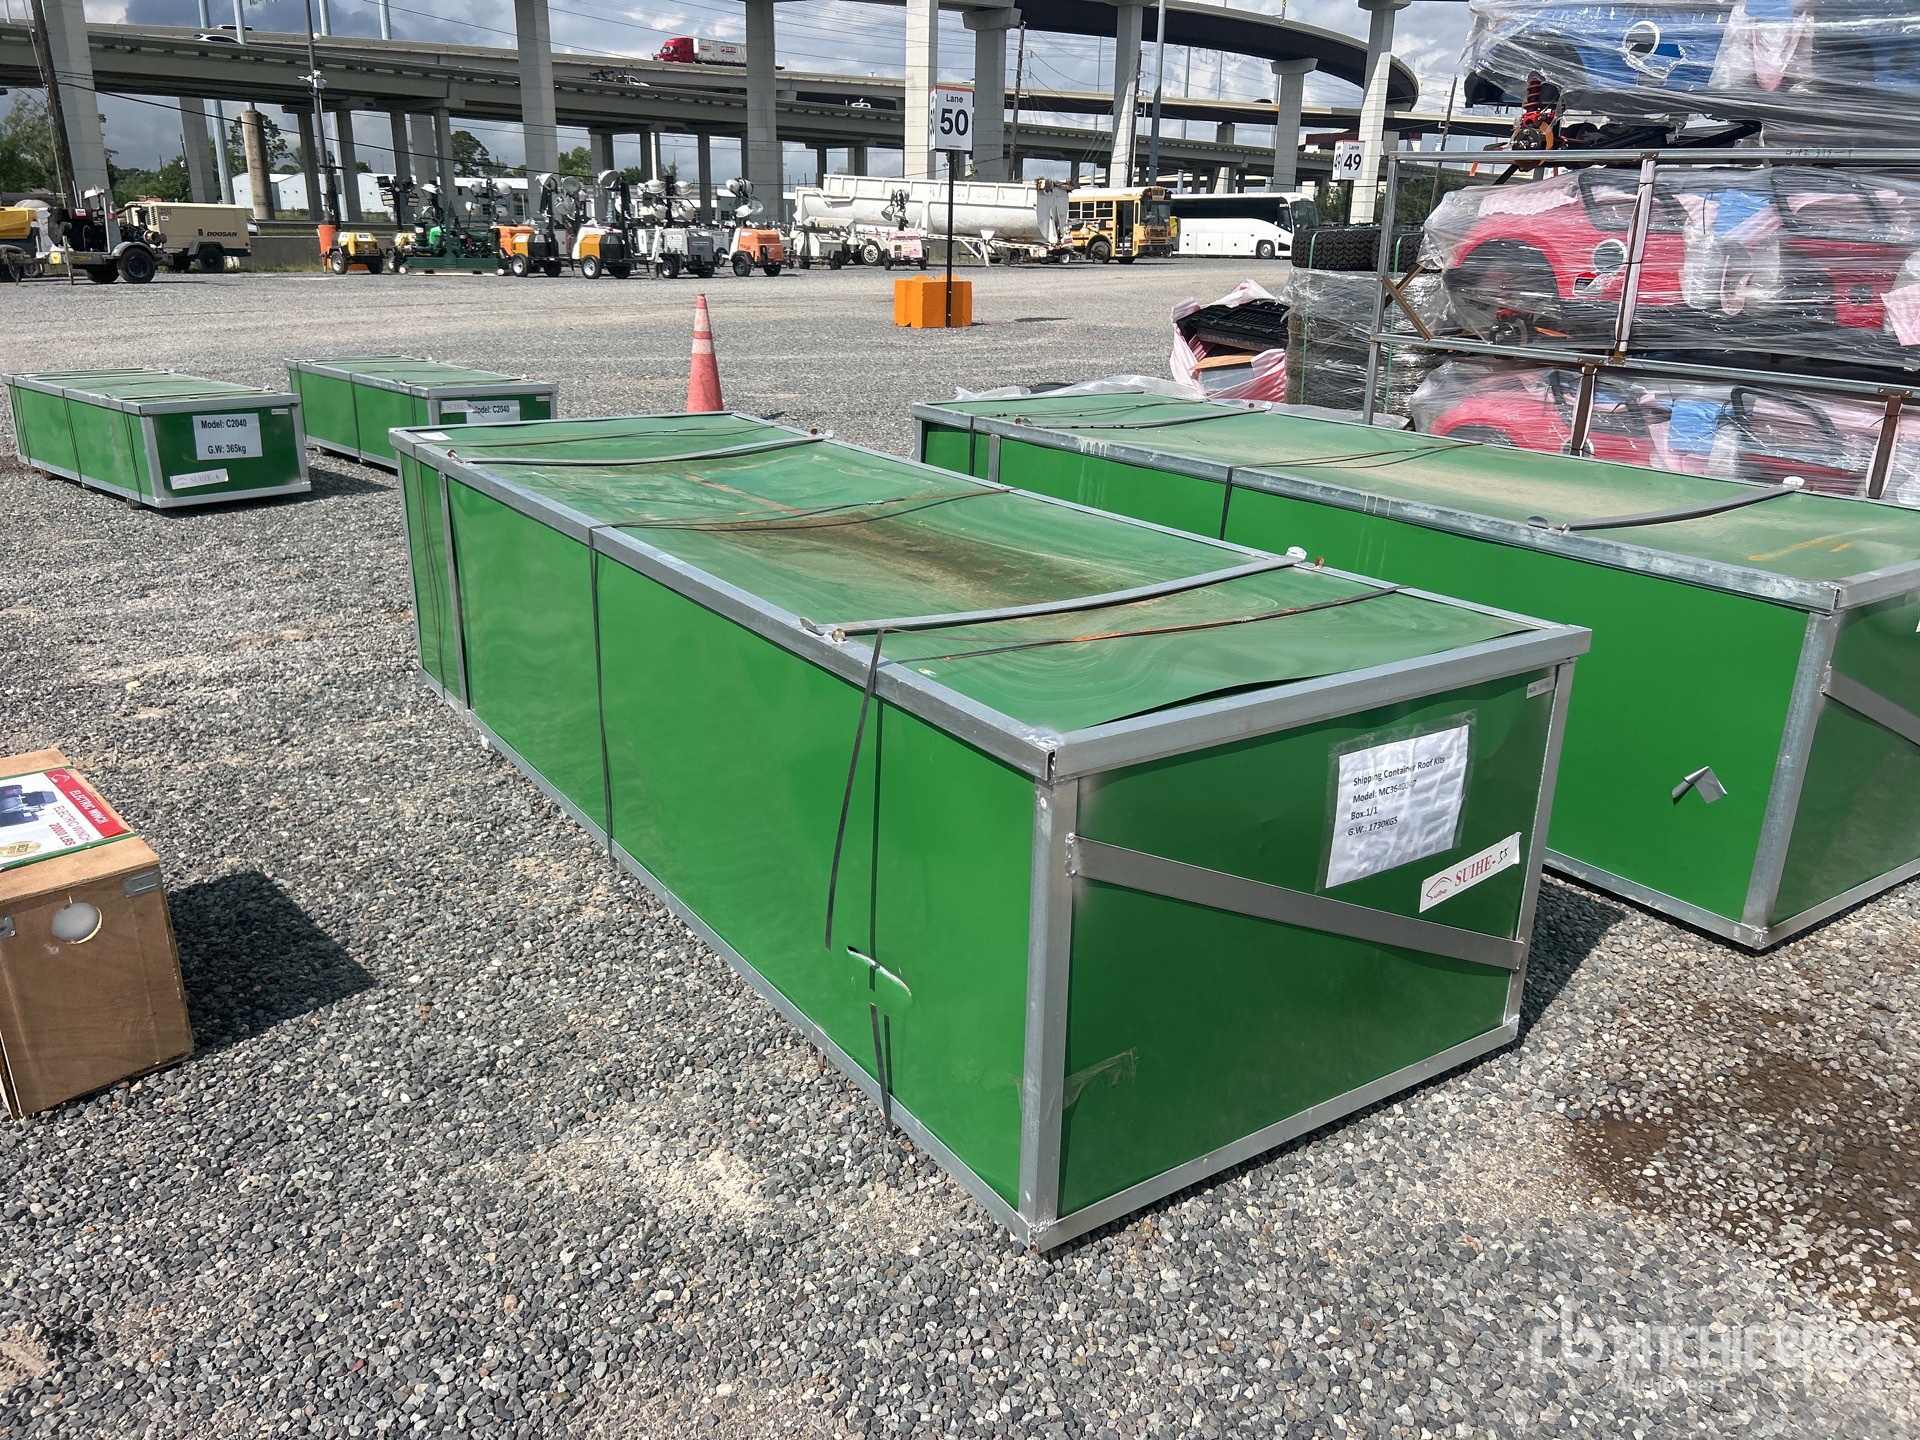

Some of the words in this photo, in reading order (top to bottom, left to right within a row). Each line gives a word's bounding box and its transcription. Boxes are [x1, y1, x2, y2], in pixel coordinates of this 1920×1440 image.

[946, 94, 964, 103] Lane
[940, 108, 969, 136] 50
[1343, 153, 1362, 171] 49
[492, 405, 510, 414] C2040
[201, 420, 225, 429] Model:
[225, 419, 247, 428] C2040
[207, 445, 225, 454] G.W:
[226, 444, 247, 454] 365kg
[1353, 772, 1382, 787] Shipping
[1383, 764, 1416, 779] Container
[1417, 758, 1433, 770] Roof
[1433, 756, 1446, 765] Kits
[1352, 790, 1377, 804] Model:
[69, 789, 95, 811] ELECTRIC
[88, 808, 110, 825] WINCH
[53, 805, 80, 827] ELECTRIC
[1368, 816, 1398, 832] 1730KGS
[59, 835, 76, 846] LBS
